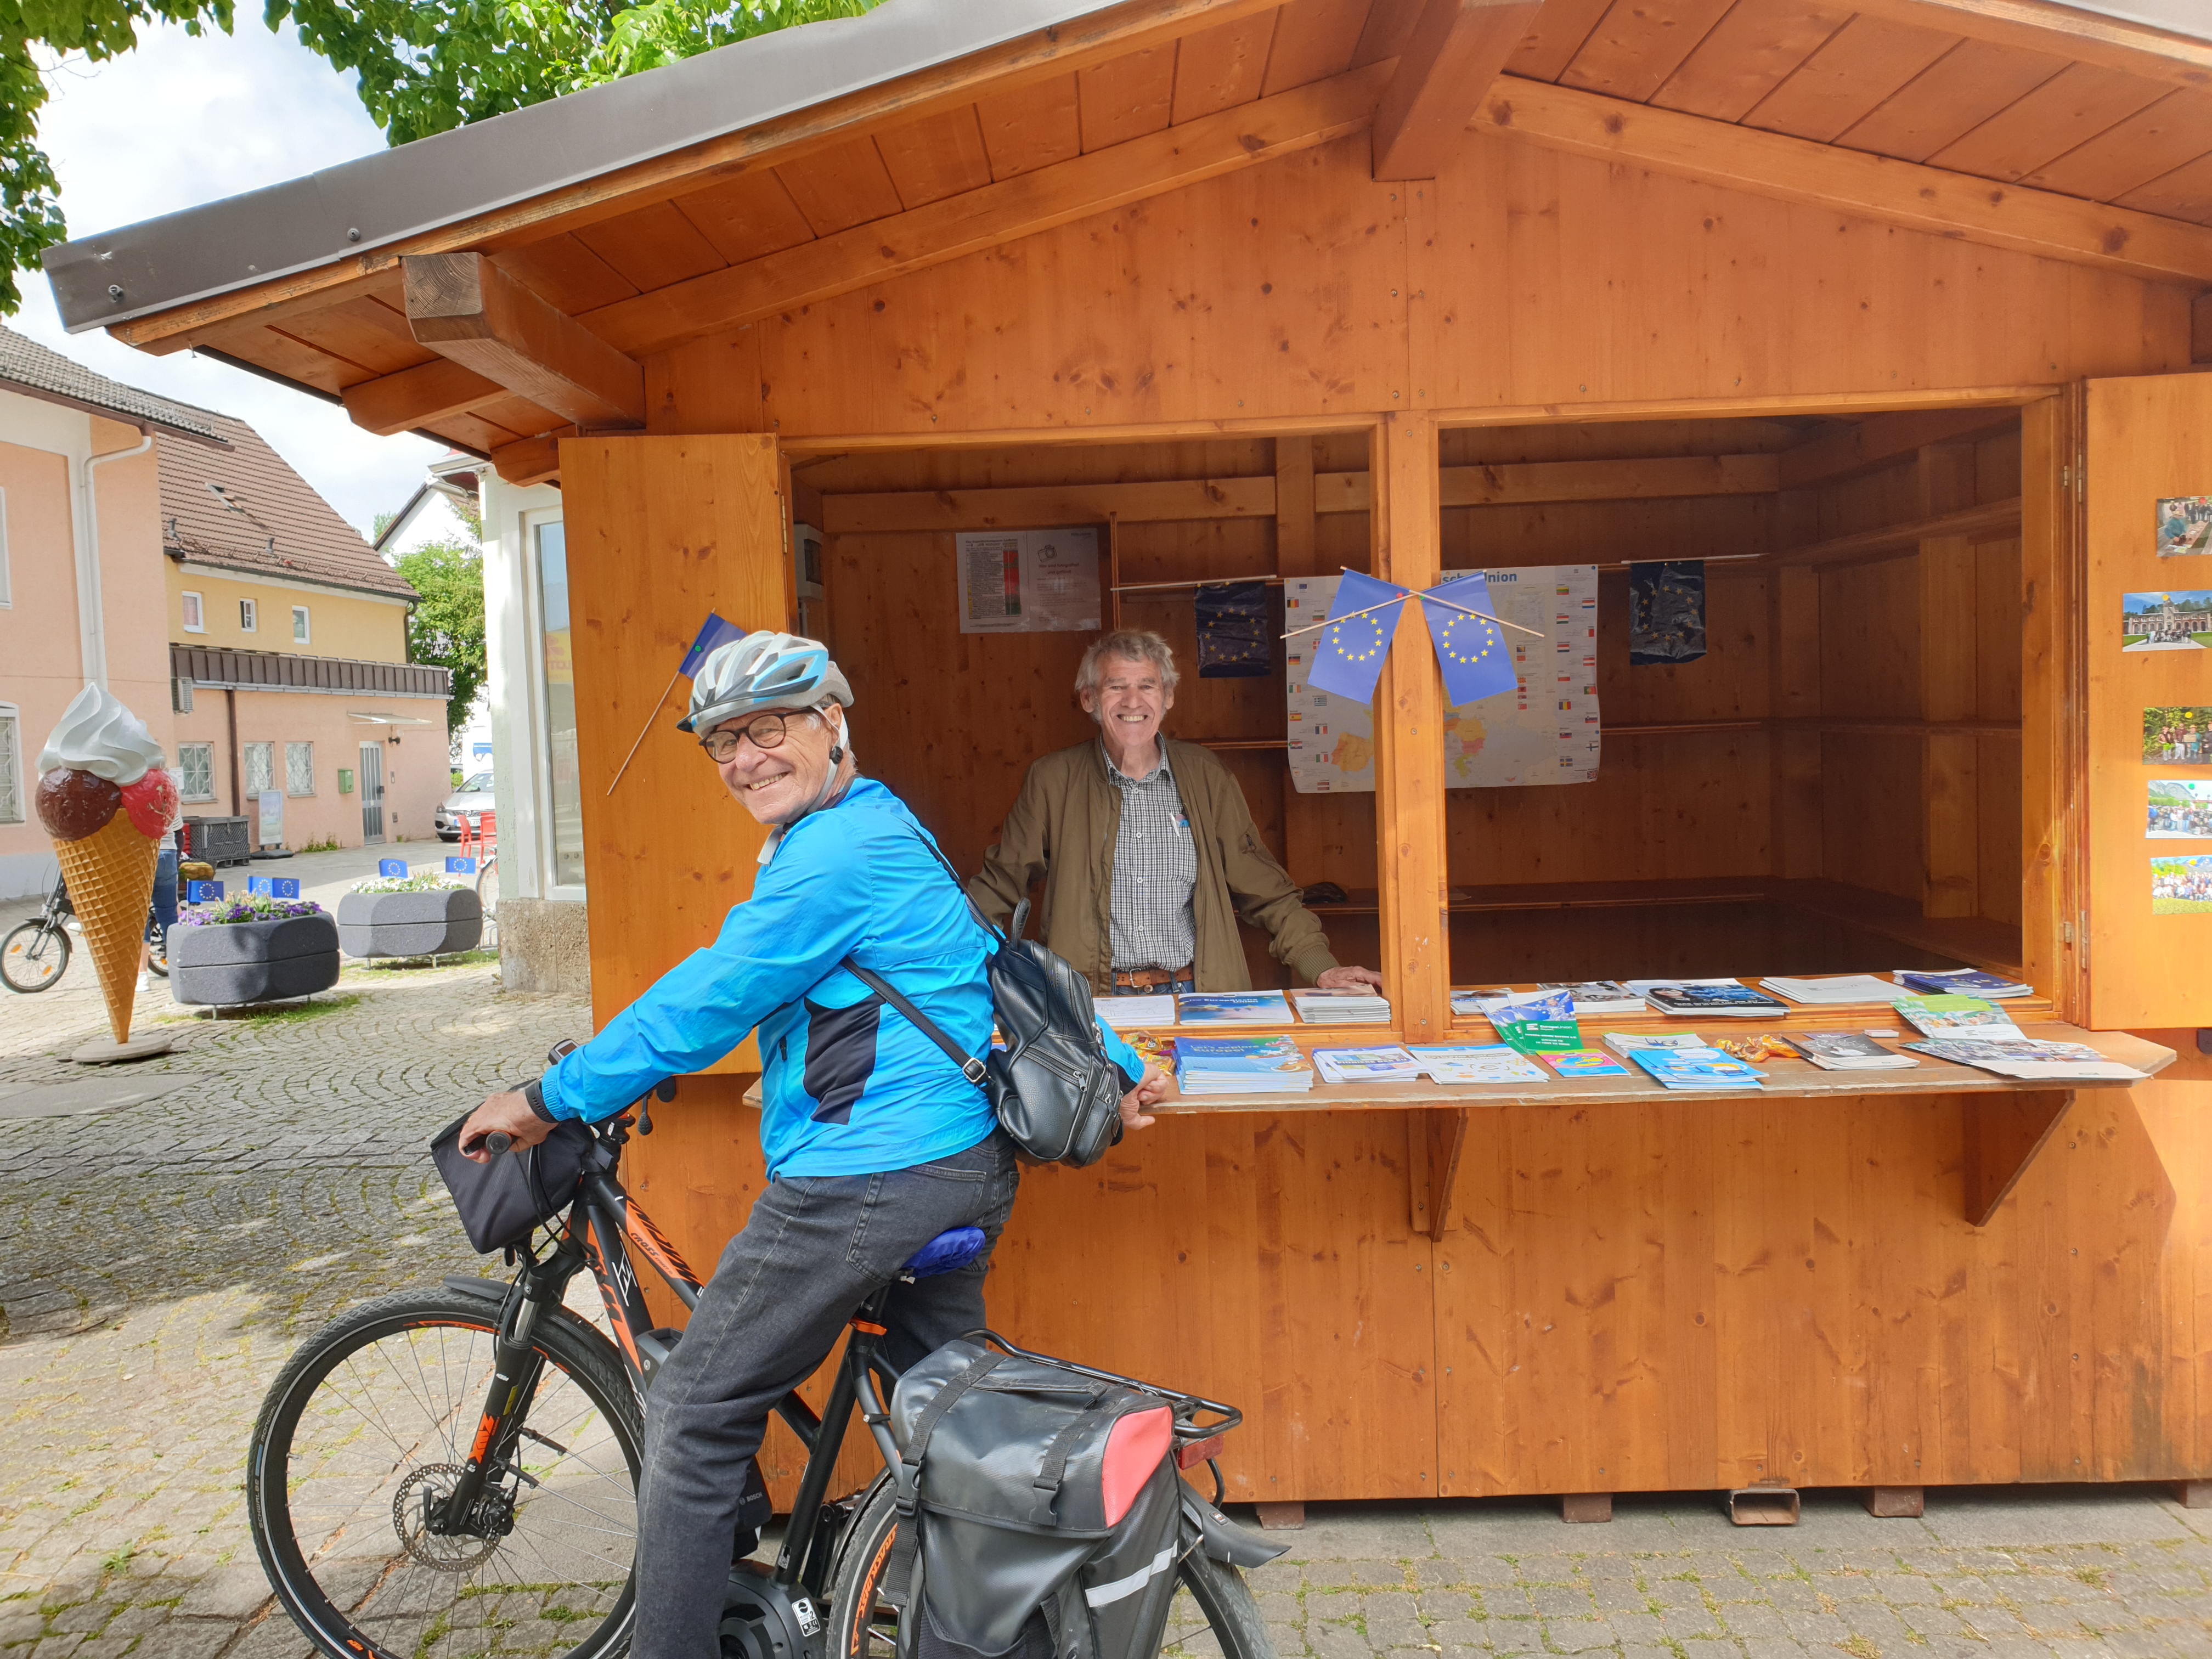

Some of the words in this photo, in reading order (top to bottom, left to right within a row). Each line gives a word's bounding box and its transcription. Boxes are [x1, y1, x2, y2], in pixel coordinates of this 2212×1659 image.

[631, 1232, 660, 1257] CROSS
[255, 1479, 264, 1530] SCHWALBE
[261, 1404, 278, 1443] MONDIAL
